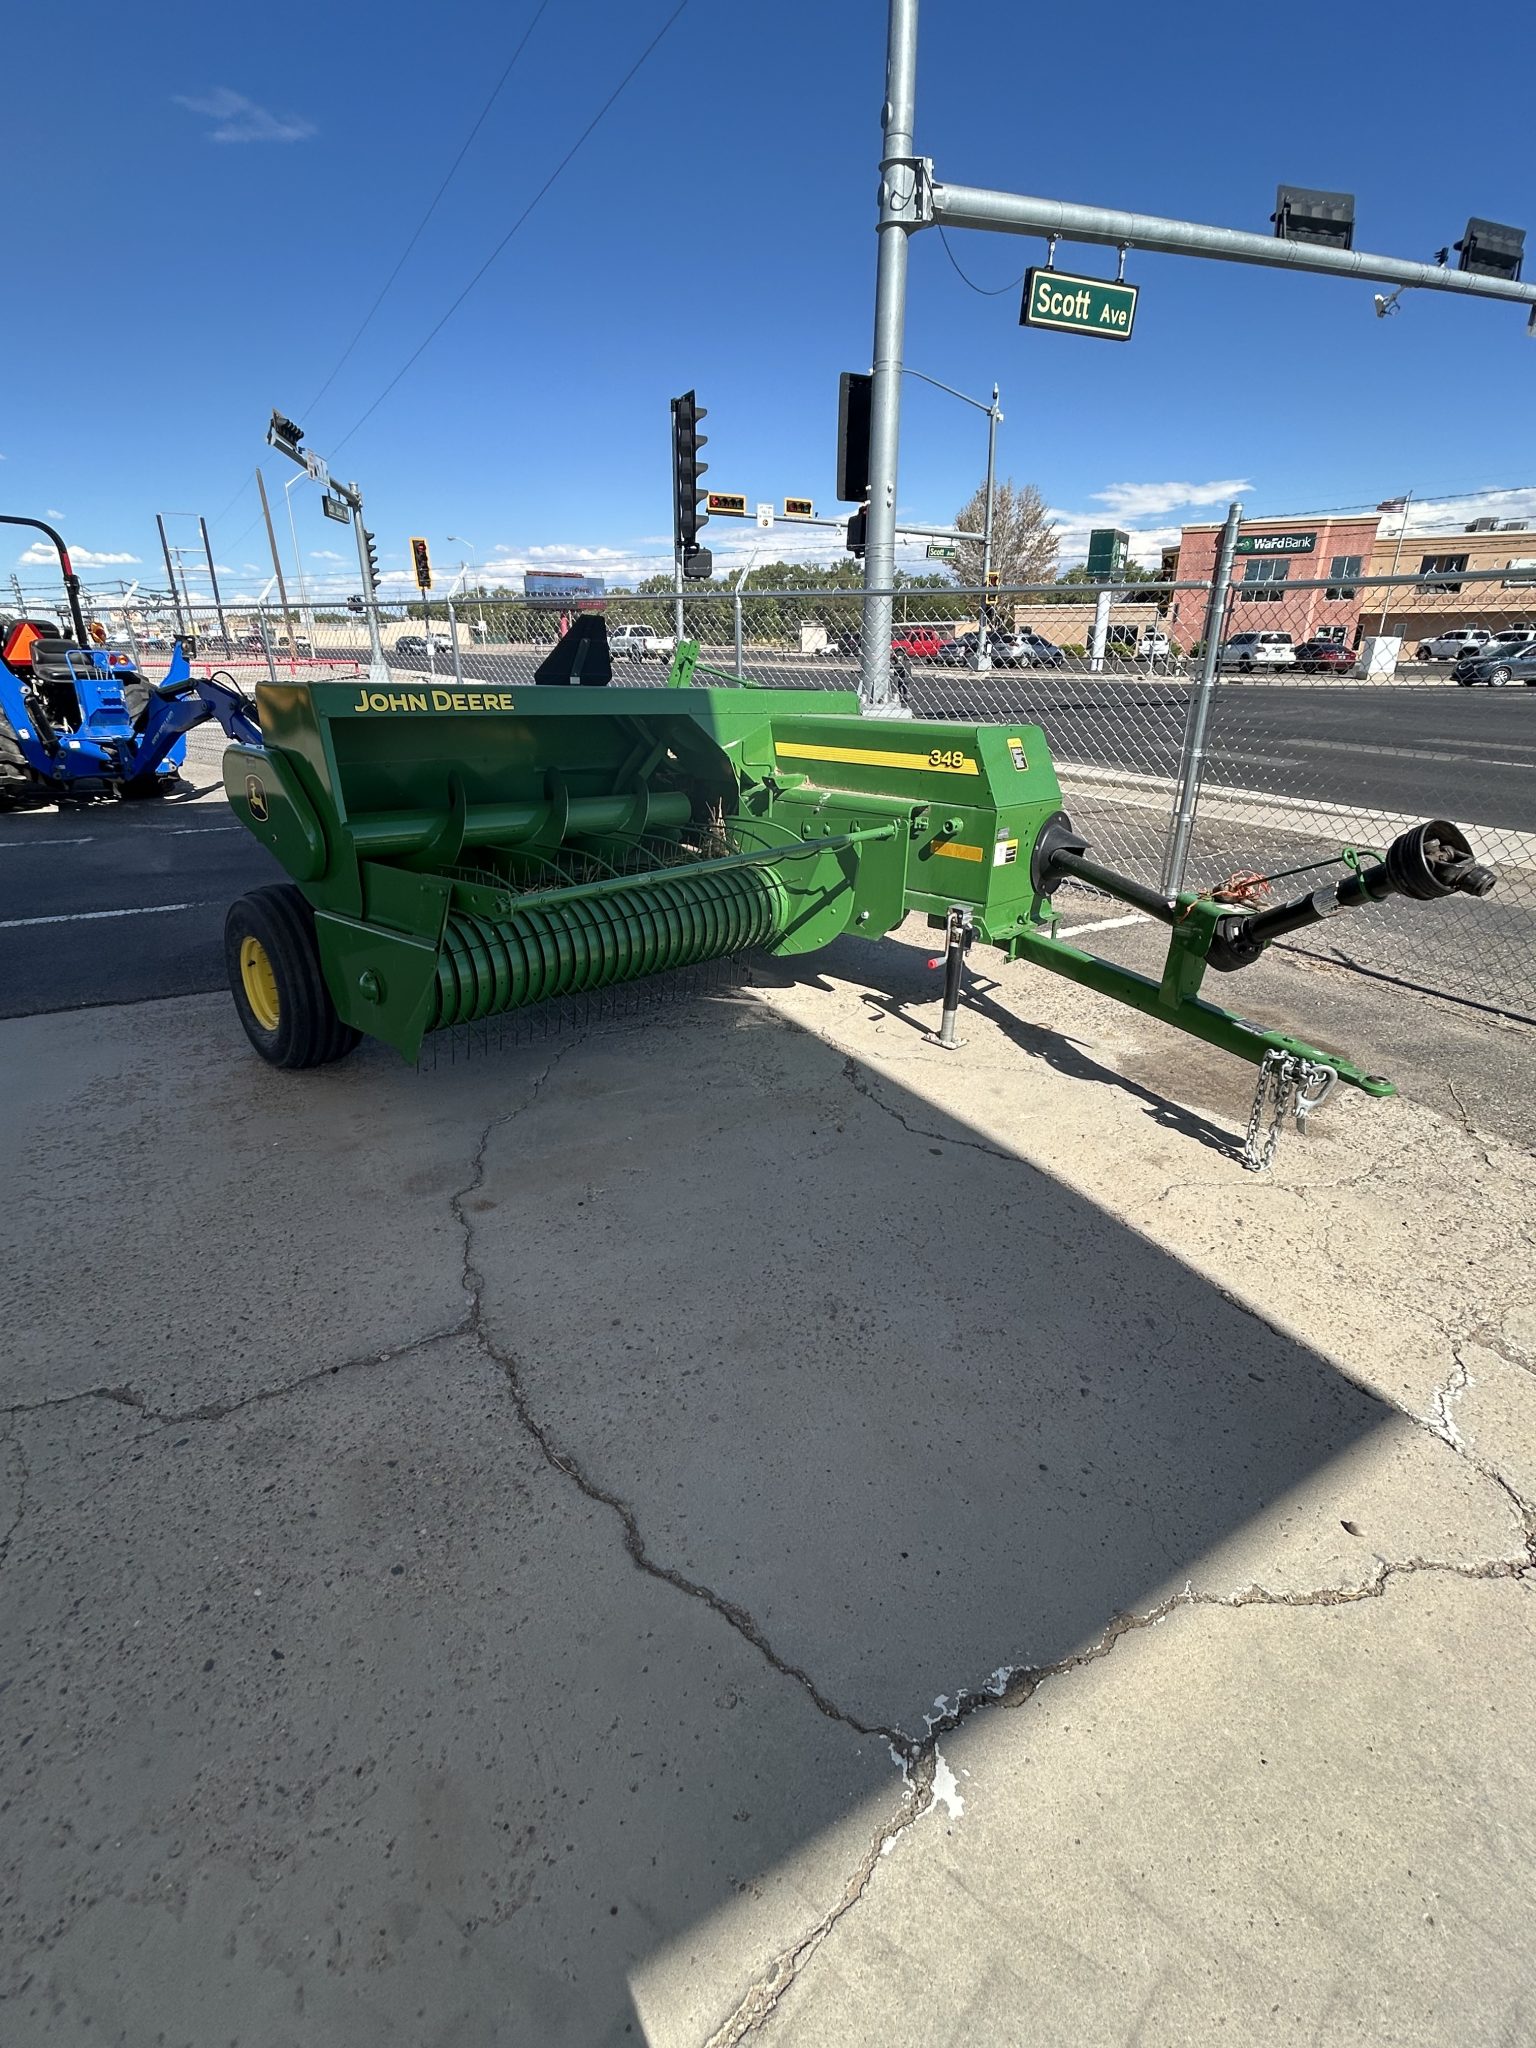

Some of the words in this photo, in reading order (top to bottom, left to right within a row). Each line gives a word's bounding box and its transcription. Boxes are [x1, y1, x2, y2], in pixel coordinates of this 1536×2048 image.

[1036, 282, 1091, 320] Scott
[1099, 303, 1127, 326] Ave
[930, 547, 945, 556] Scott
[354, 689, 428, 712] JOHN
[431, 689, 515, 711] DEERE
[929, 749, 964, 768] 348
